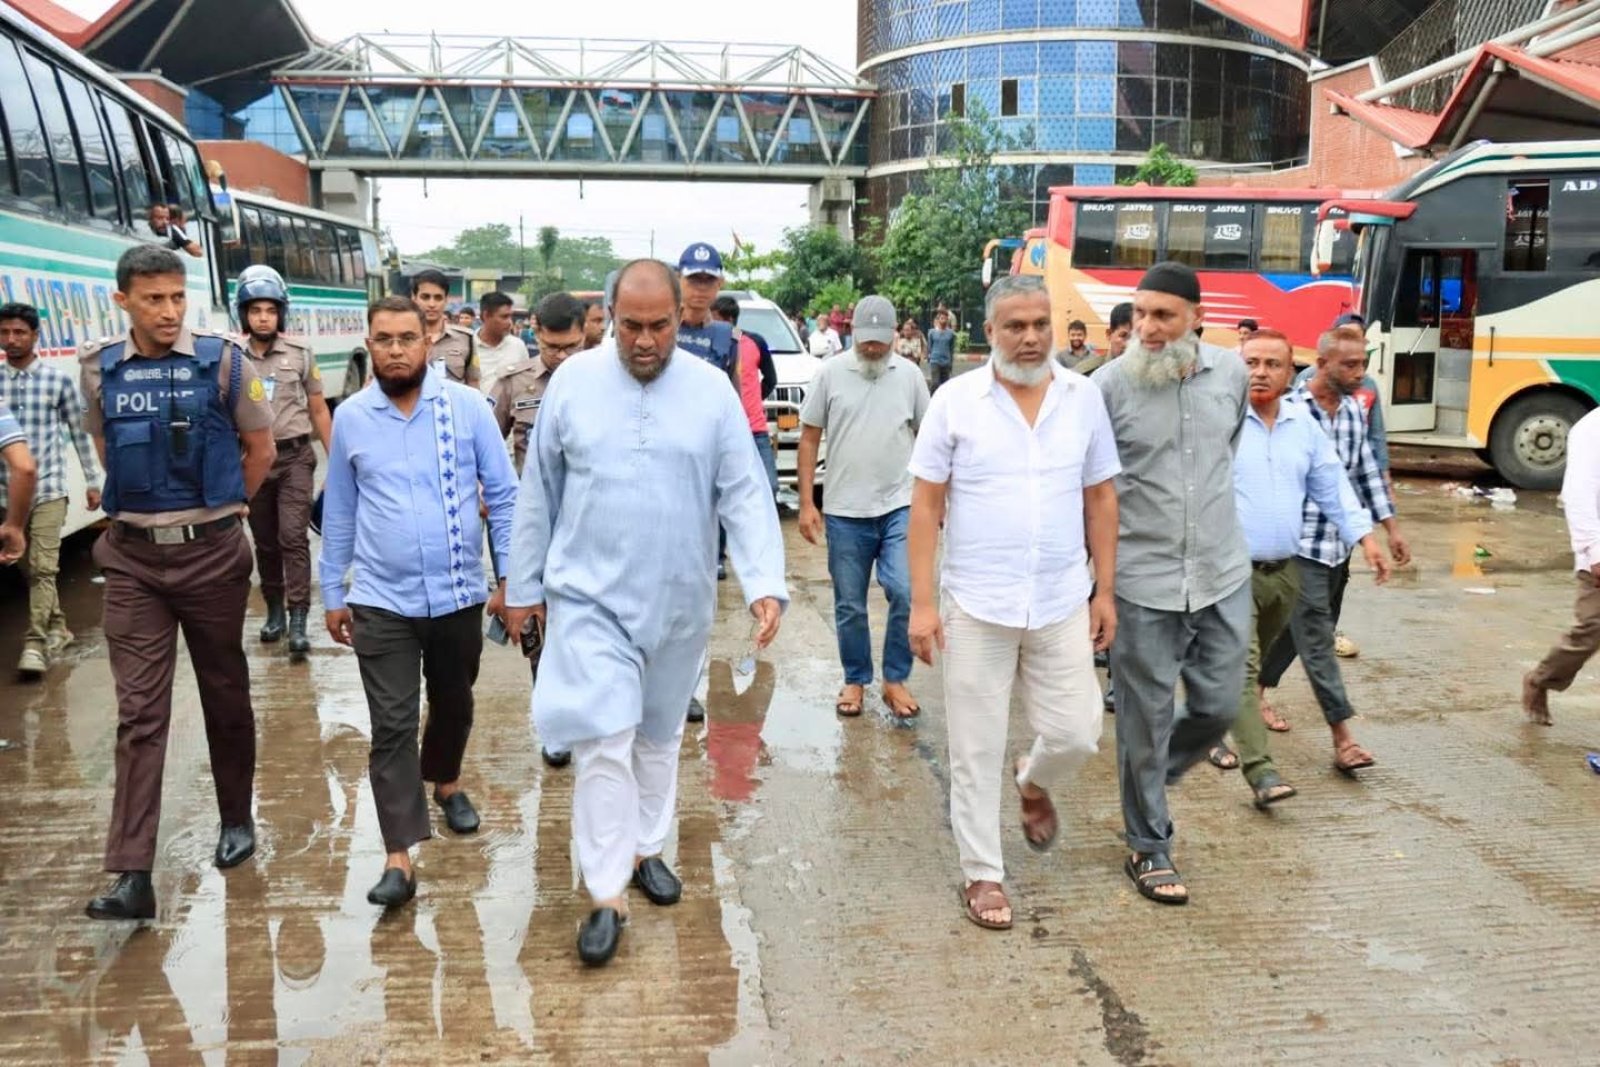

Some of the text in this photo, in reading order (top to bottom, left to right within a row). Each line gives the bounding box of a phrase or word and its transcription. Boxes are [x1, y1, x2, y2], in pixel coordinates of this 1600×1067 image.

[1082, 203, 1154, 212] SHUVO JATRA
[1172, 204, 1246, 214] SHUVO JATRA
[1266, 206, 1301, 215] SHUVO
[116, 390, 195, 414] POL
